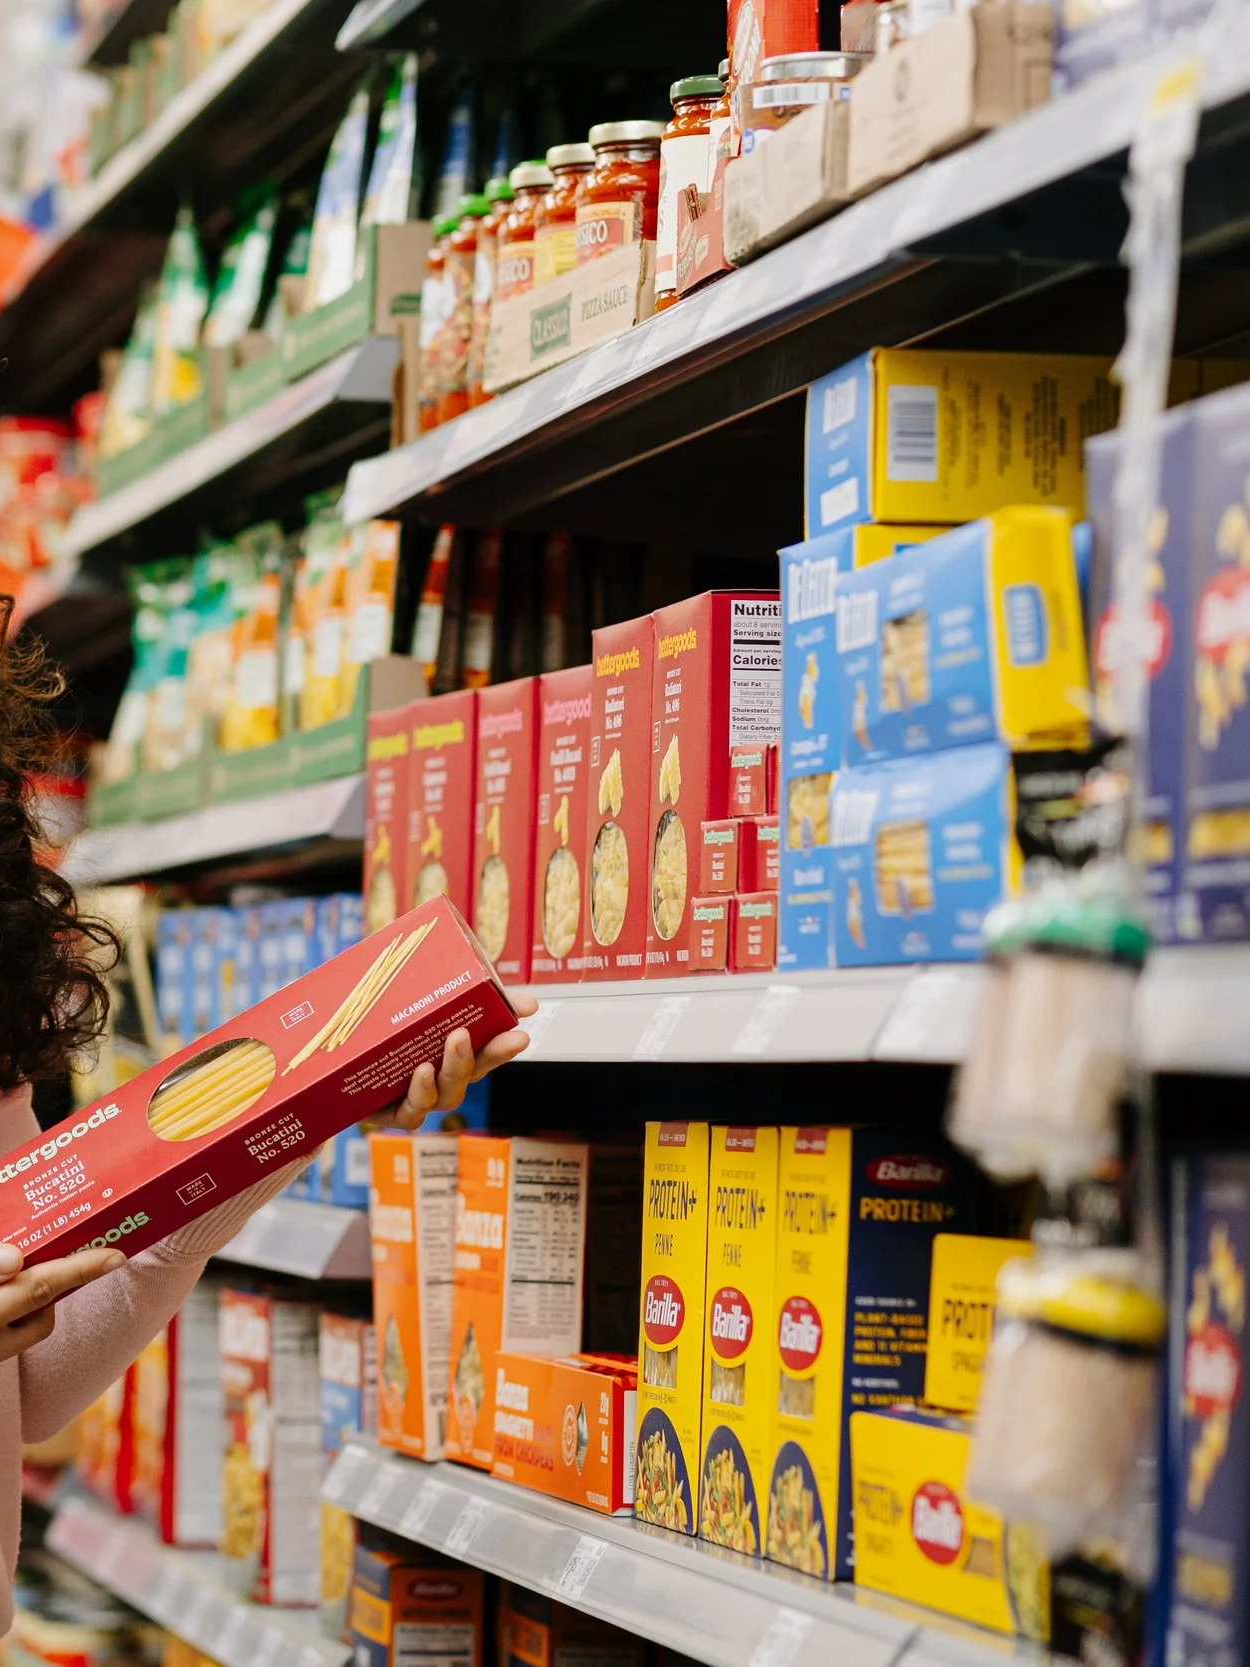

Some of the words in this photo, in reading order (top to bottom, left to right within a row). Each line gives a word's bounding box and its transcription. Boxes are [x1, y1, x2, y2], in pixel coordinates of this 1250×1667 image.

[604, 285, 628, 313] SAUCE
[733, 629, 764, 637] Serving
[391, 994, 434, 1025] MACARONI
[433, 970, 471, 999] PRODUCT
[341, 1081, 357, 1093] ideal
[357, 1074, 370, 1083] with
[377, 1057, 399, 1072] creamy
[399, 1037, 430, 1058] traditional
[431, 1030, 442, 1039] red
[442, 1018, 464, 1032] tomato
[464, 1007, 483, 1019] sauce.
[344, 1075, 357, 1083] This
[357, 1062, 378, 1076] bronze
[379, 1055, 389, 1063] cut
[389, 1040, 414, 1057] Bucatini
[424, 1027, 436, 1035] 520
[436, 1018, 451, 1028] long
[451, 1008, 468, 1020] pasta
[348, 1087, 362, 1095] This
[362, 1076, 379, 1089] pasta
[386, 1062, 403, 1074] made
[410, 1049, 424, 1059] Italy
[424, 1039, 441, 1050] using
[460, 1014, 484, 1029] ountain
[371, 1077, 388, 1089] water
[390, 1062, 414, 1079] sourced
[414, 1054, 429, 1064] from
[388, 1076, 403, 1087] extra
[244, 1124, 277, 1145] BRONZE
[278, 1113, 294, 1125] CUT
[247, 1119, 302, 1156] Bucatini
[257, 1149, 280, 1164] No.
[281, 1131, 305, 1149] 520
[23, 1166, 58, 1190] BRONZE
[61, 1154, 77, 1167] CUT
[25, 1160, 85, 1202] Bucatini
[877, 1160, 944, 1182] Barilla
[31, 1202, 58, 1220] Authentic
[59, 1191, 78, 1203] Italian
[79, 1180, 95, 1193] pasta
[32, 1194, 58, 1210] No.
[59, 1174, 86, 1194] 520
[648, 1179, 697, 1220] PROTEIN+
[715, 1186, 766, 1229] PROTEIN+
[859, 1196, 955, 1223] PROTEIN+
[12, 1226, 27, 1237] texture
[18, 1238, 30, 1249] 16
[30, 1230, 43, 1242] OZ
[43, 1224, 52, 1235] (1
[53, 1215, 68, 1228] LB)
[69, 1202, 91, 1218] 454g
[654, 1233, 674, 1257] PENNE
[722, 1242, 742, 1268] PENNE
[645, 1291, 678, 1327] Barilla
[712, 1303, 747, 1342] Barilla
[779, 1312, 820, 1354] Barilla
